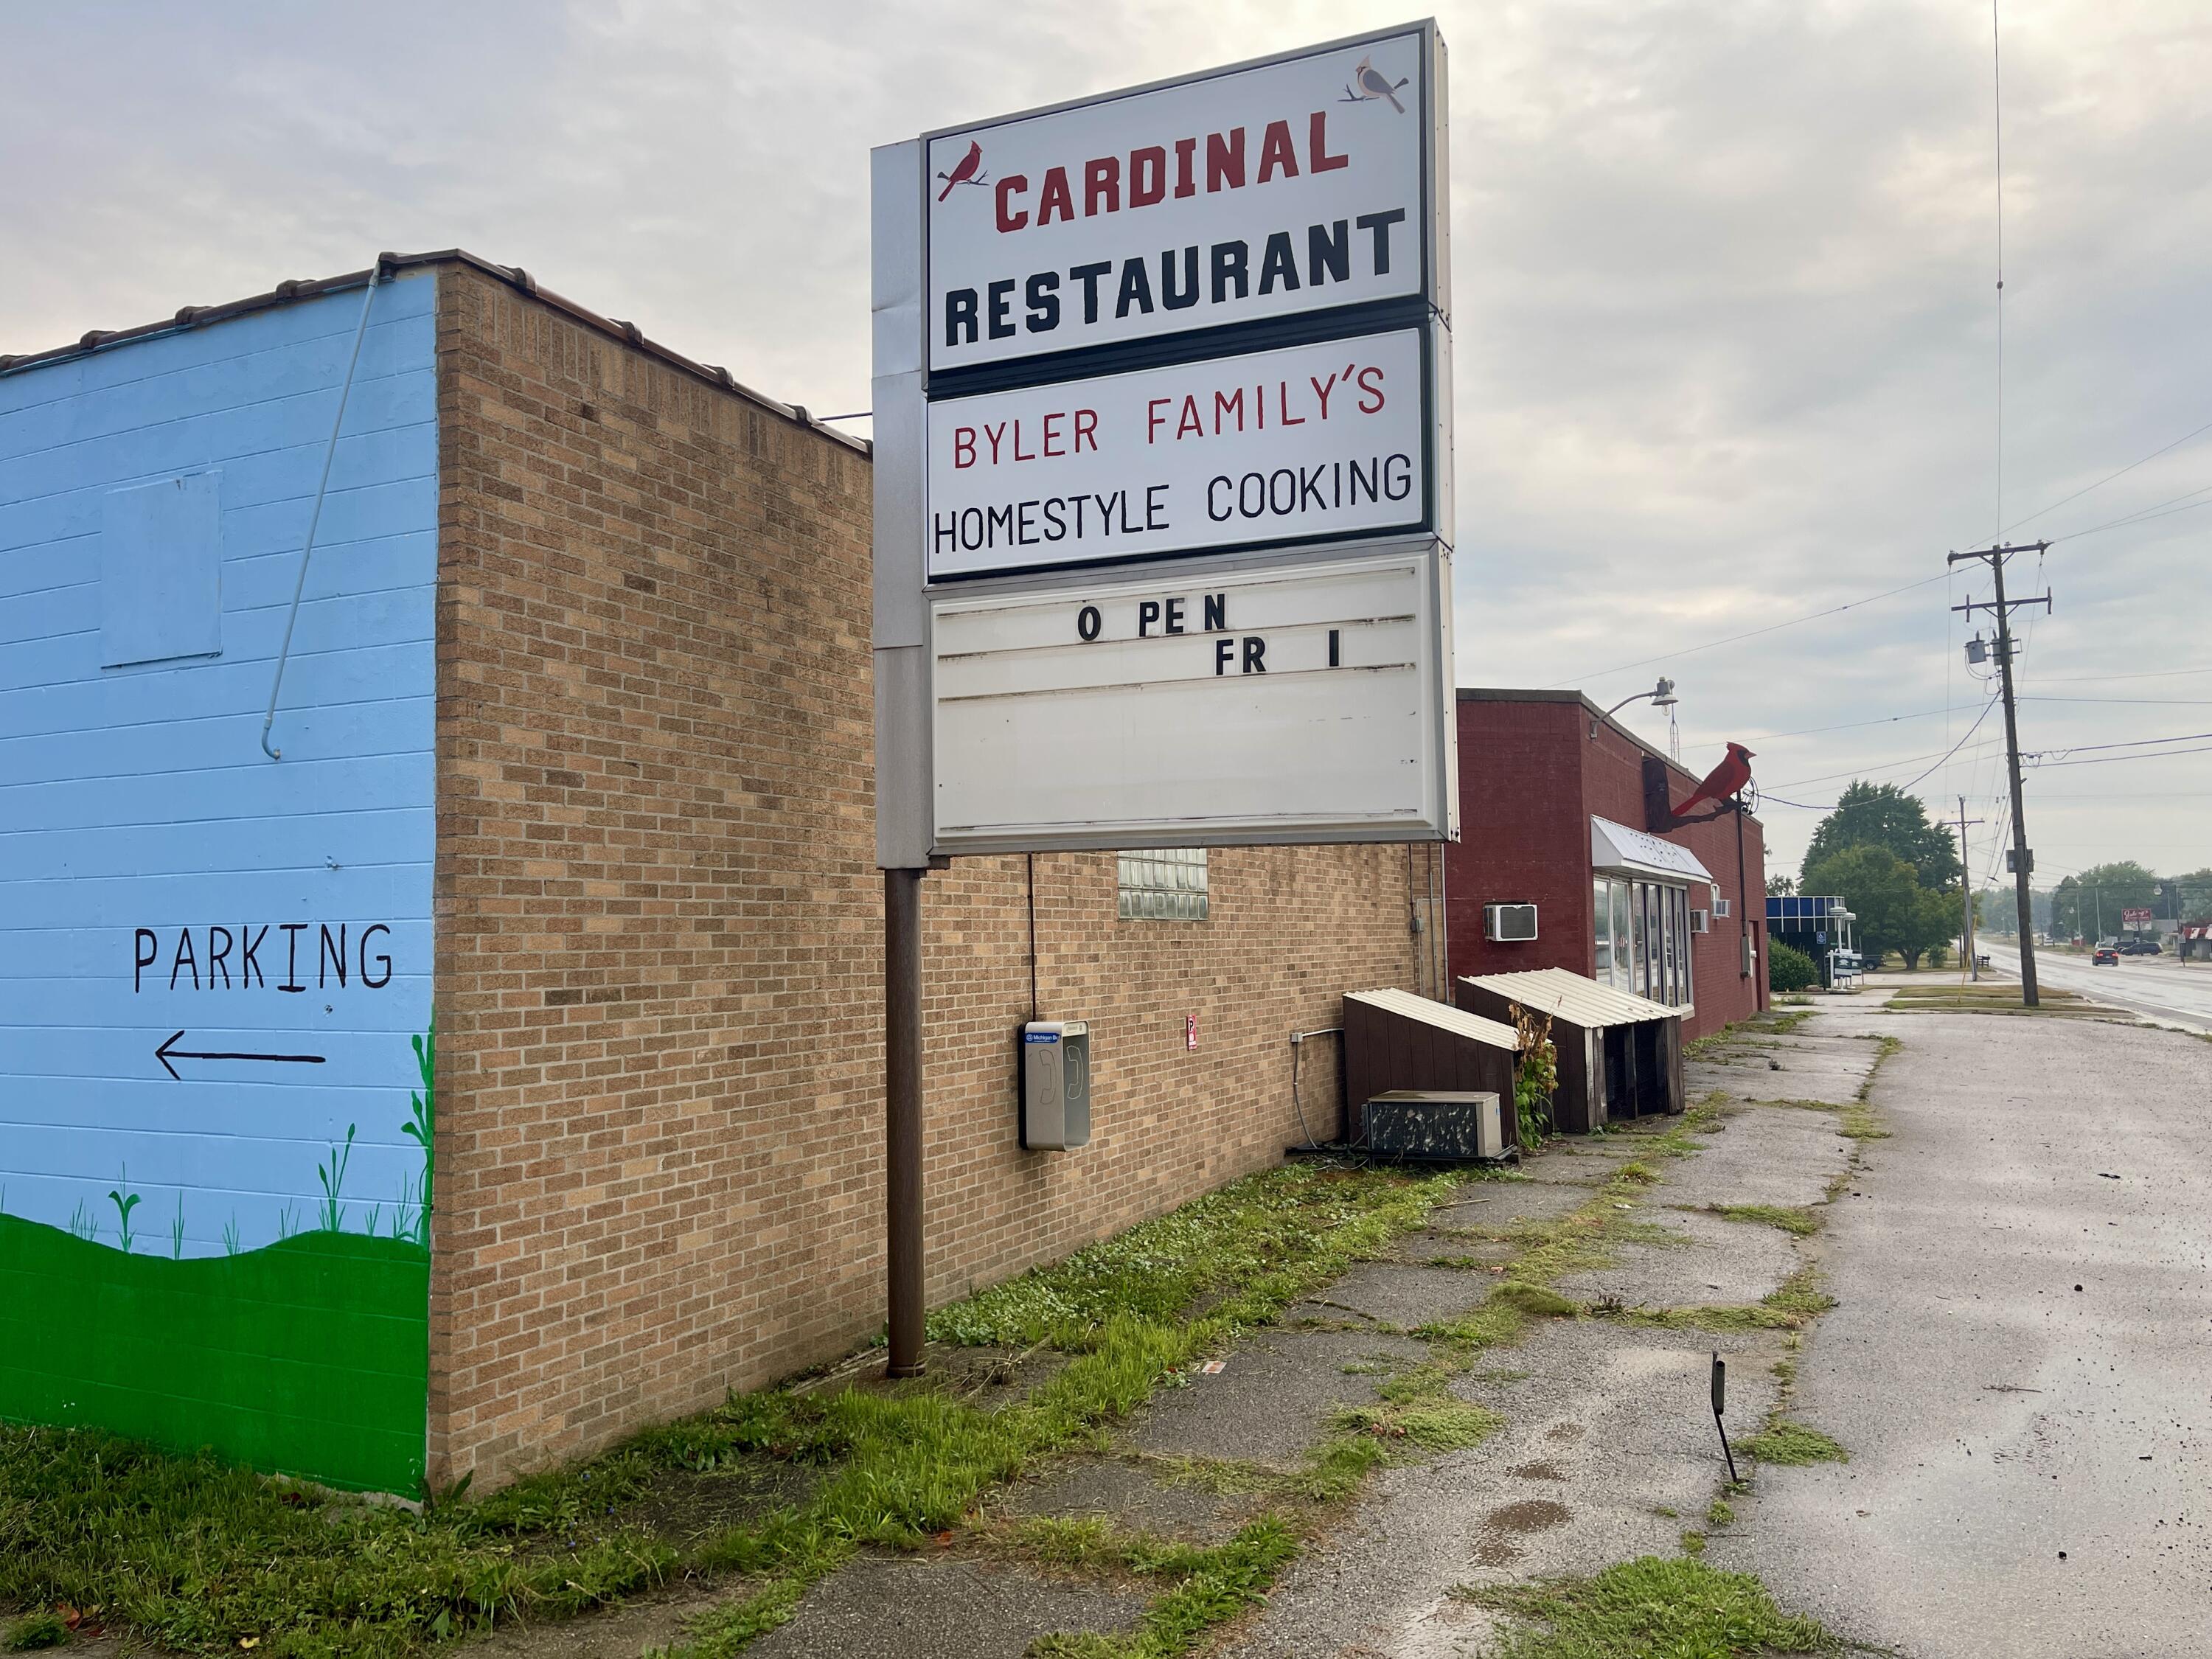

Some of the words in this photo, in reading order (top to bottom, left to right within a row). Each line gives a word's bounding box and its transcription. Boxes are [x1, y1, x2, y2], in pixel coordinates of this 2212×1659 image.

[995, 111, 1349, 233] CARDINAL
[946, 208, 1405, 347] RESTAURANT
[954, 409, 1099, 469] BYLER
[1148, 364, 1385, 444] FAMILY'S
[934, 484, 1170, 554] HOMESTYLE
[1207, 453, 1412, 522] COOKING
[134, 923, 392, 993] PARKING
[1033, 1034, 1052, 1043] Michigan
